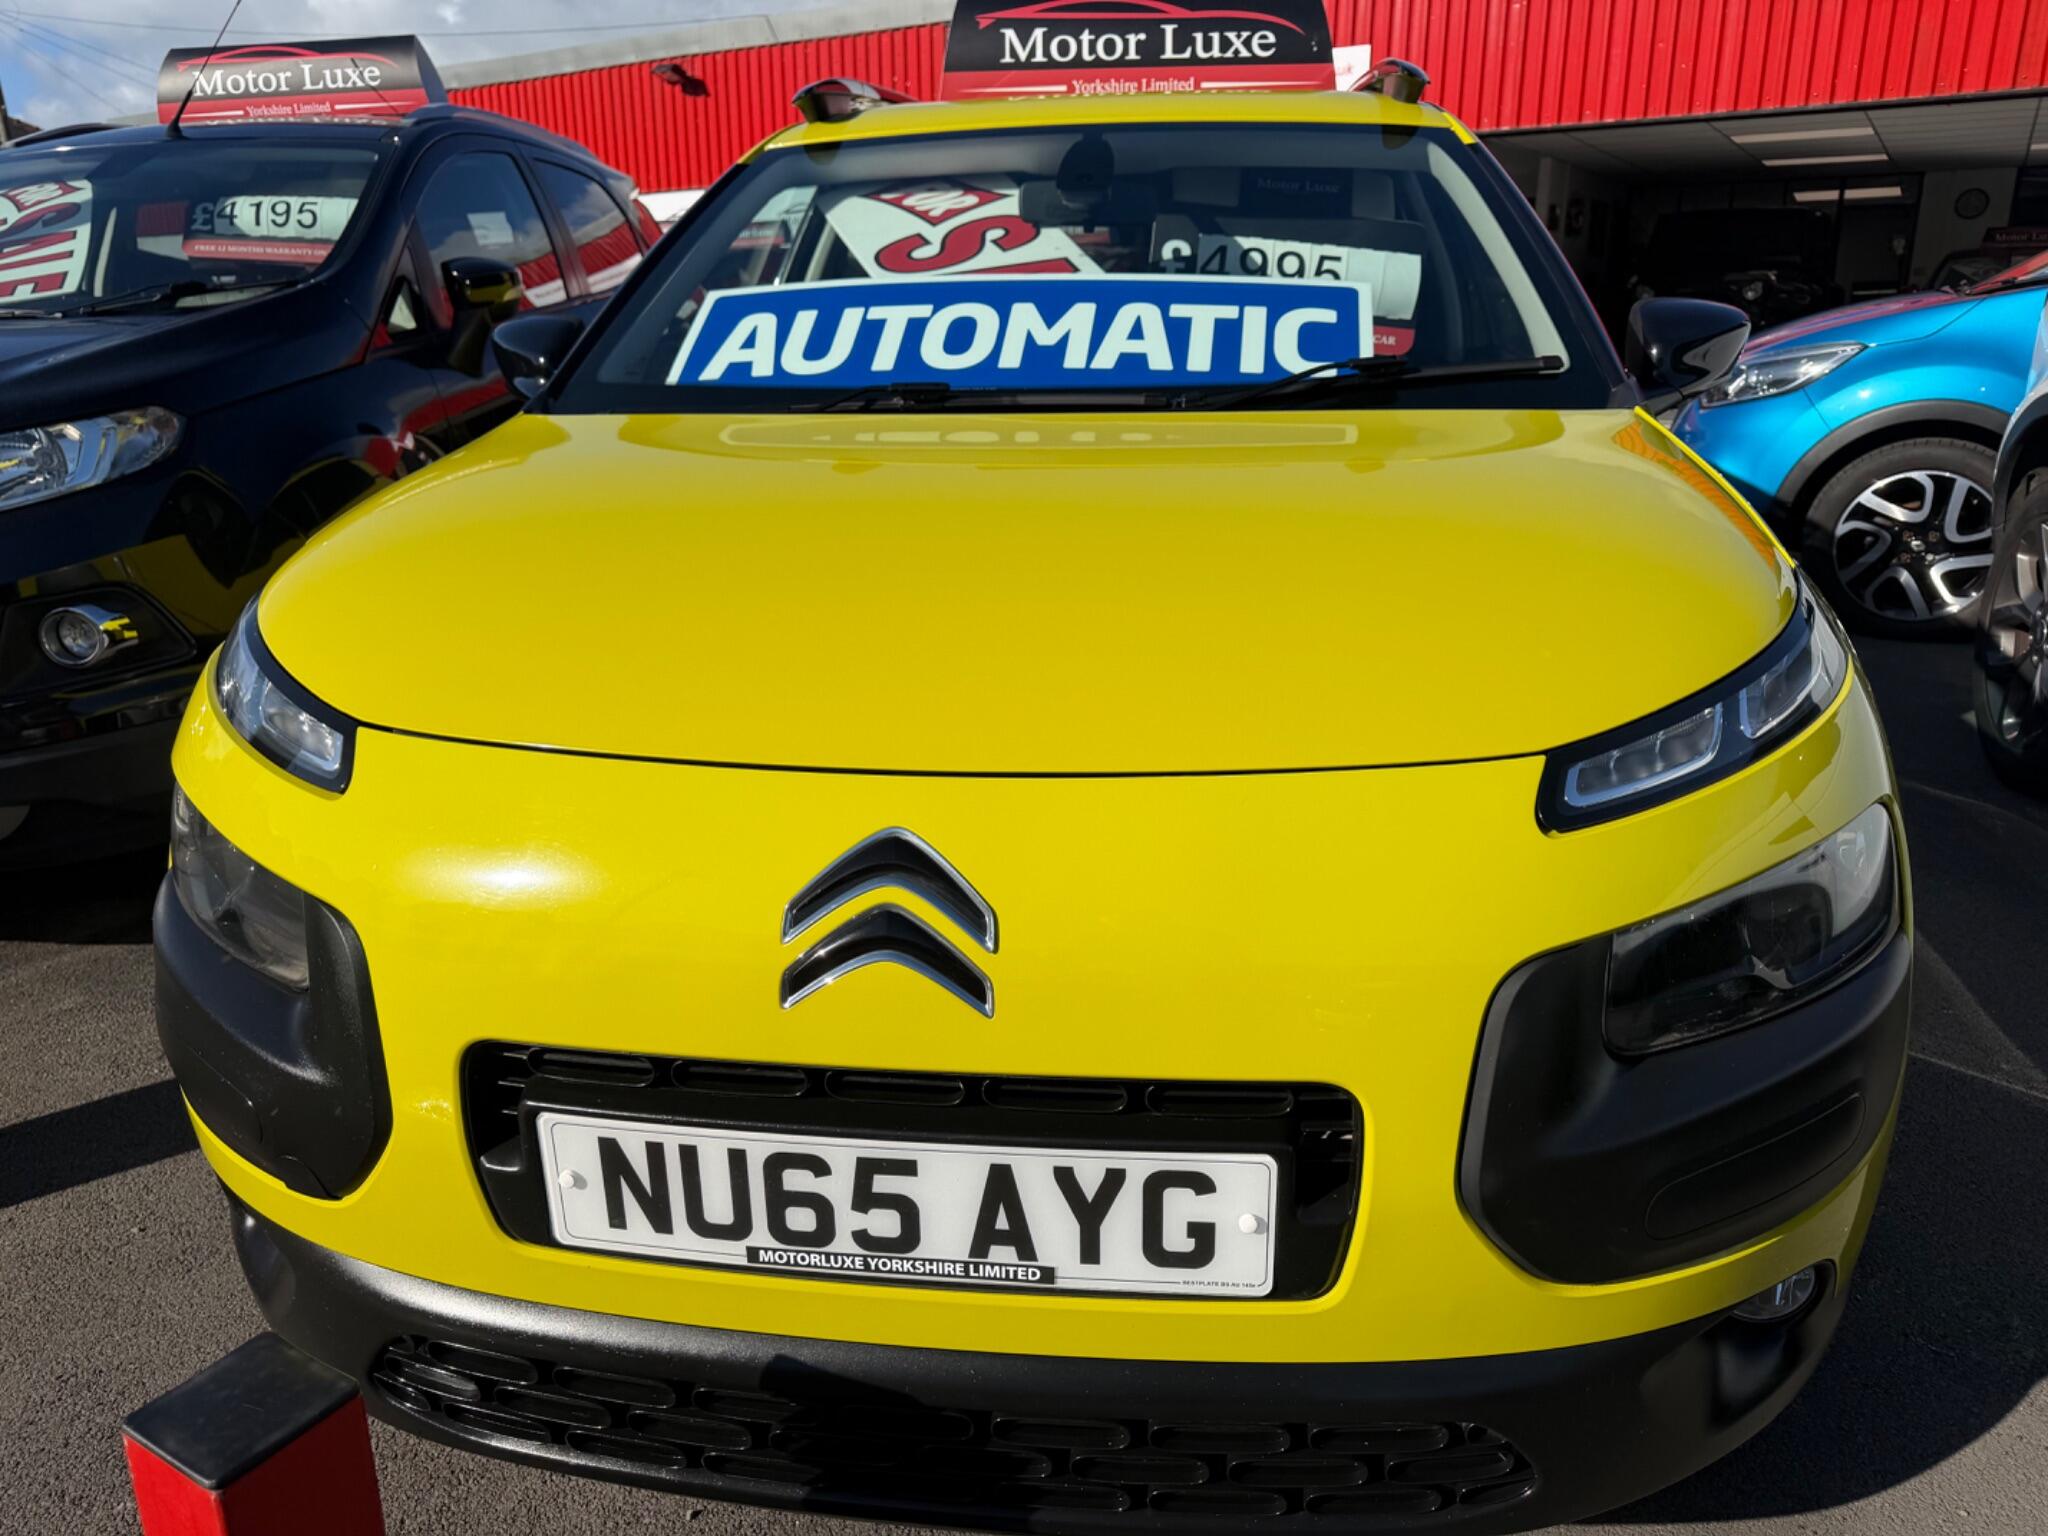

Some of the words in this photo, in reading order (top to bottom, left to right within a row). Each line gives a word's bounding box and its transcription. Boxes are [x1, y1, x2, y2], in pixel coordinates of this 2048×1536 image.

[1000, 26, 1146, 63] Motor
[1160, 24, 1277, 60] Luxe
[193, 68, 292, 97] Motor
[300, 63, 382, 91] Luxe
[1072, 79, 1137, 95] Yorkshire
[1141, 77, 1194, 93] Limited
[246, 104, 293, 118] Yorkshire
[293, 102, 331, 115] Limited
[1257, 178, 1301, 191] Motor
[191, 200, 319, 231] £4195
[194, 244, 217, 252] FREE
[265, 247, 313, 256] WARRANTY
[698, 301, 1338, 381] AUTOMATIC
[1373, 334, 1397, 346] CAR
[597, 1136, 922, 1256] NU65
[968, 1162, 1218, 1270] AYG
[759, 1249, 864, 1271] MOTORLUXE
[867, 1257, 965, 1277] YORKSHIRE
[970, 1264, 1041, 1281] LIMITED
